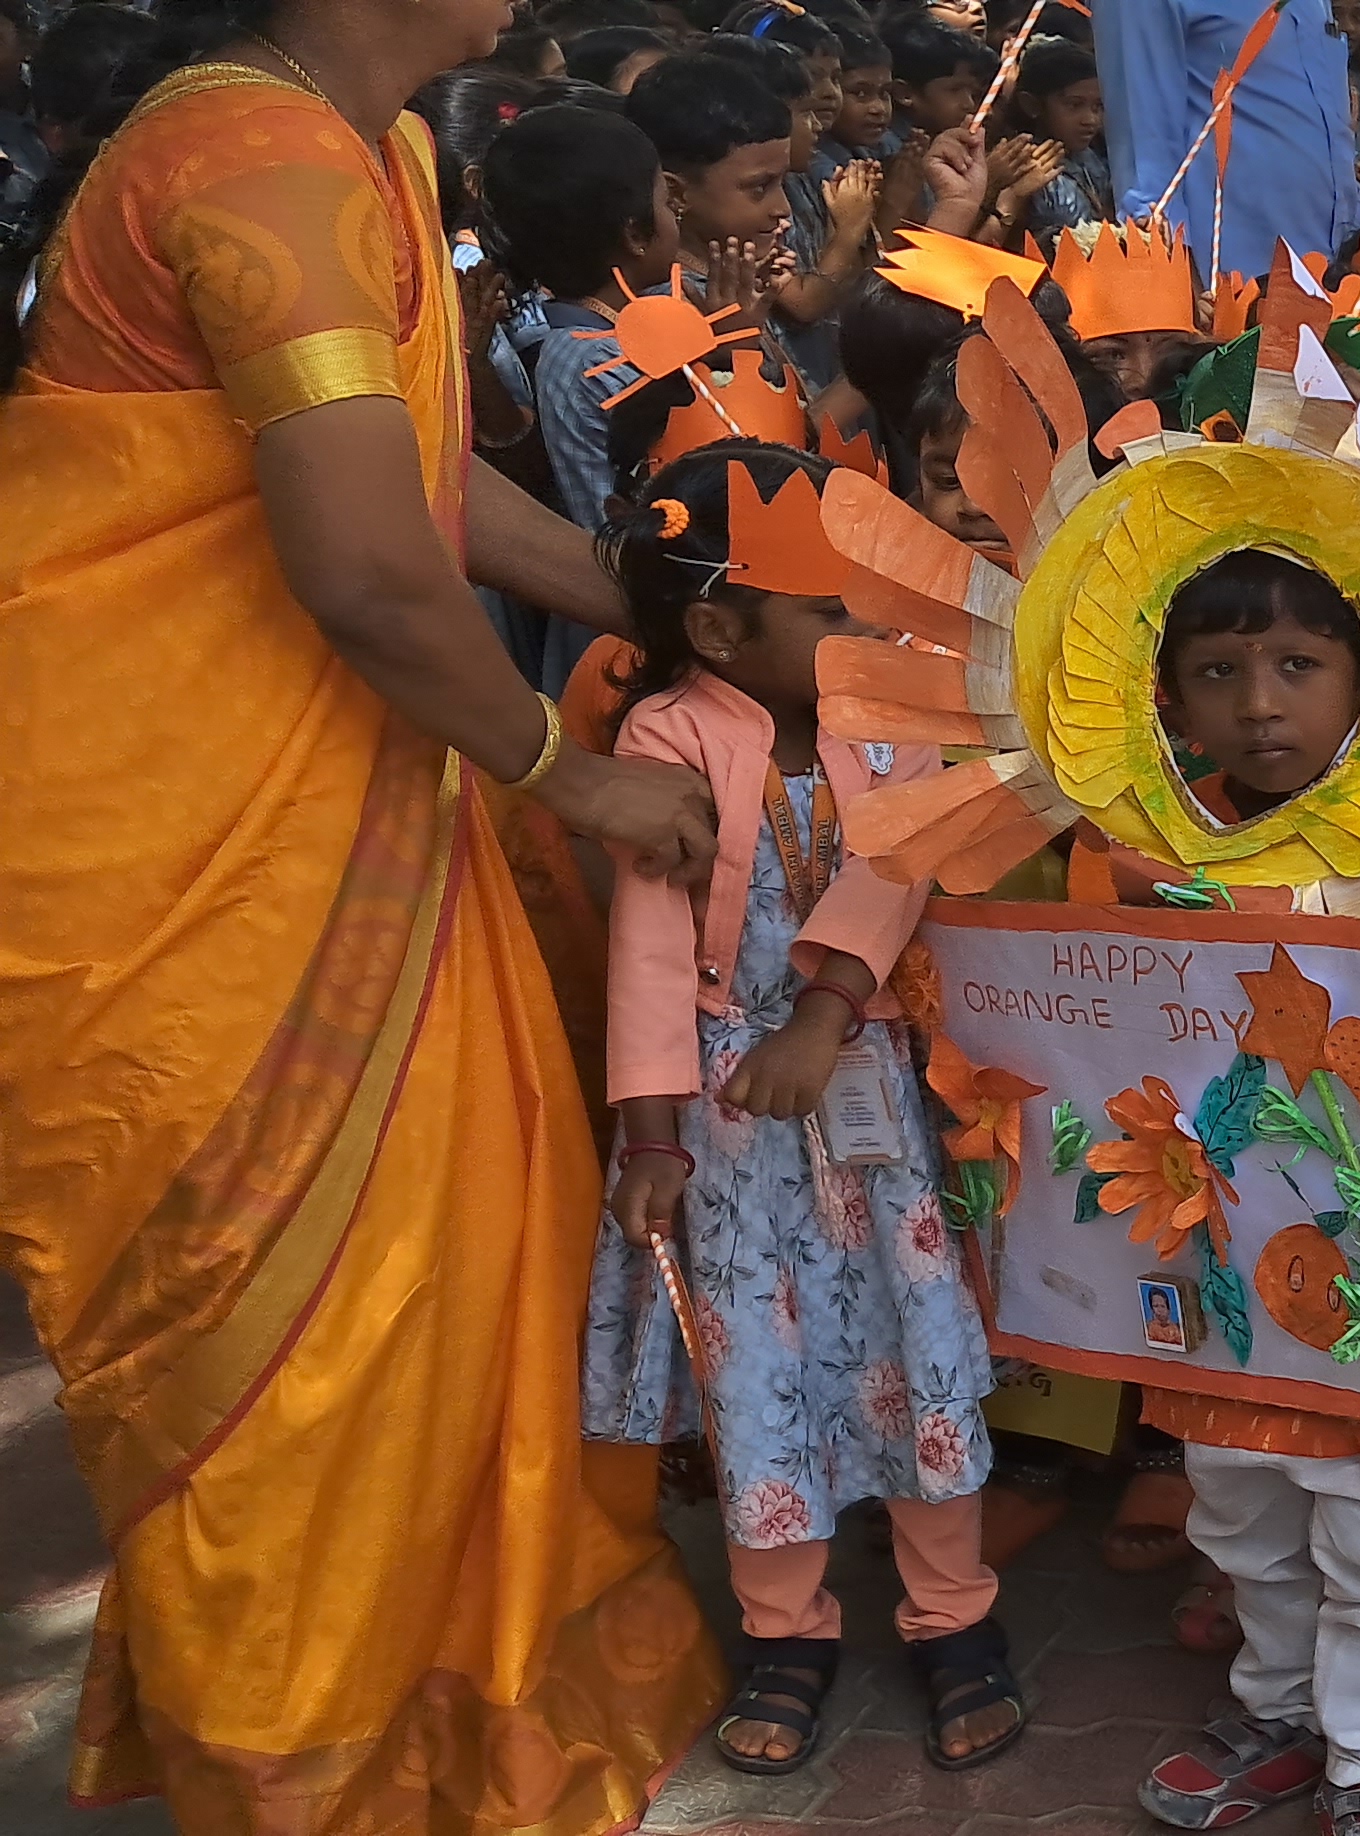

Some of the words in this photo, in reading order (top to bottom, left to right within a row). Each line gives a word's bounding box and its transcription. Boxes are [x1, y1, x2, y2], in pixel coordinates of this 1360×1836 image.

[772, 795, 794, 847] AMBAL
[816, 816, 831, 870] AMBAL
[1052, 941, 1196, 993] HAPPY
[963, 980, 1115, 1031] ORANGE
[1159, 1001, 1250, 1044] DAY
